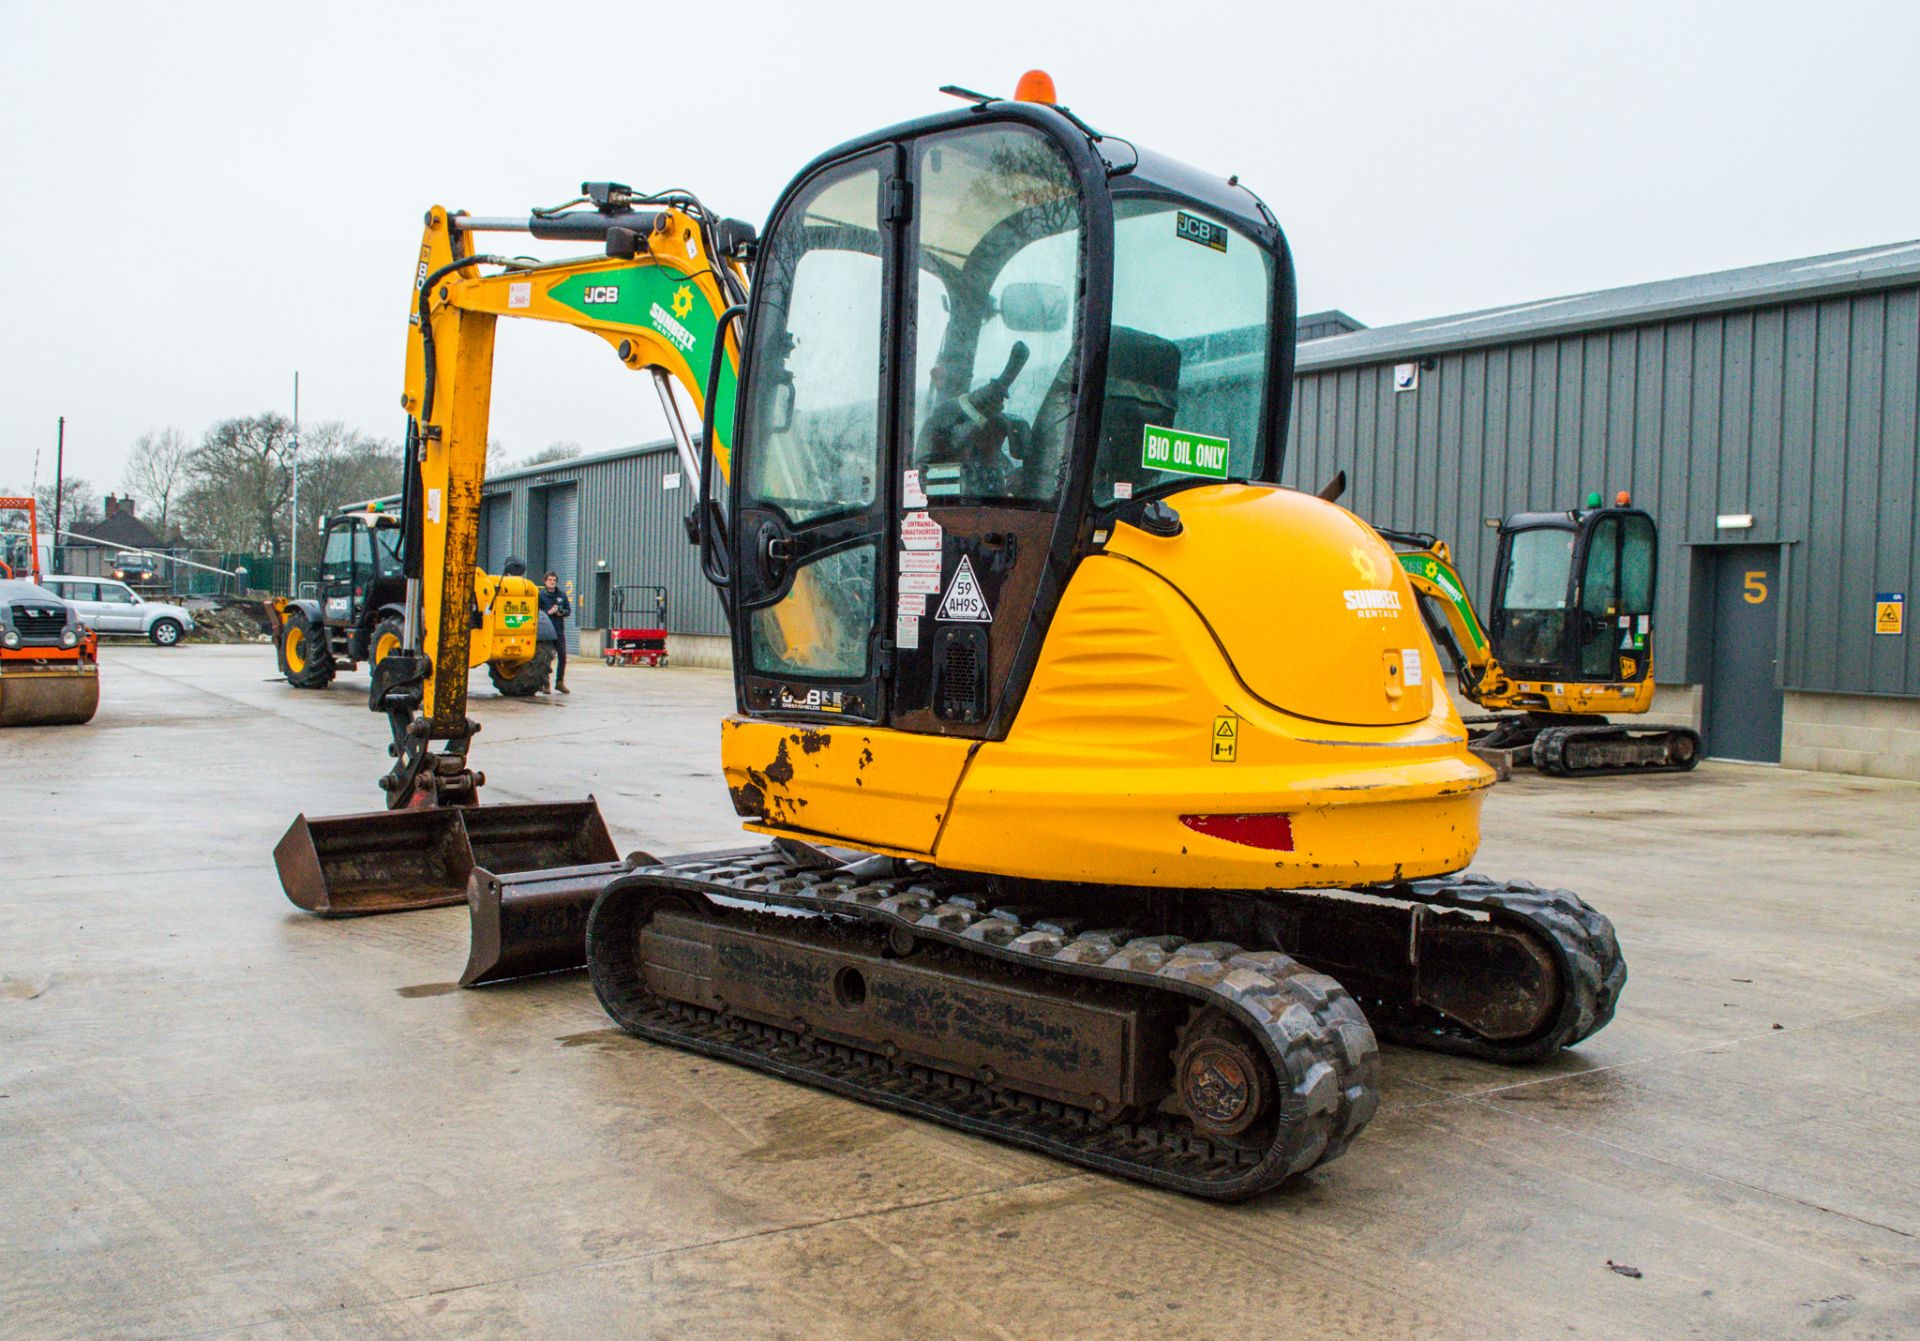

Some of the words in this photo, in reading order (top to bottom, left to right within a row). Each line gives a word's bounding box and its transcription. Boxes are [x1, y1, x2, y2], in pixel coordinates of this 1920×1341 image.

[1178, 214, 1211, 241] JCB
[584, 286, 618, 303] JCB
[649, 302, 697, 352] SUNBELT
[652, 320, 685, 352] RENTALS
[1148, 435, 1170, 462] BIO
[1173, 440, 1192, 465] OIL
[1196, 444, 1225, 470] ONLY
[902, 528, 940, 536] UNAUTHORISED
[957, 582, 971, 595] 59
[1744, 571, 1768, 604] 5
[949, 598, 978, 612] AH9S
[1343, 590, 1401, 609] SUNBELT
[1357, 610, 1398, 618] RENTALS
